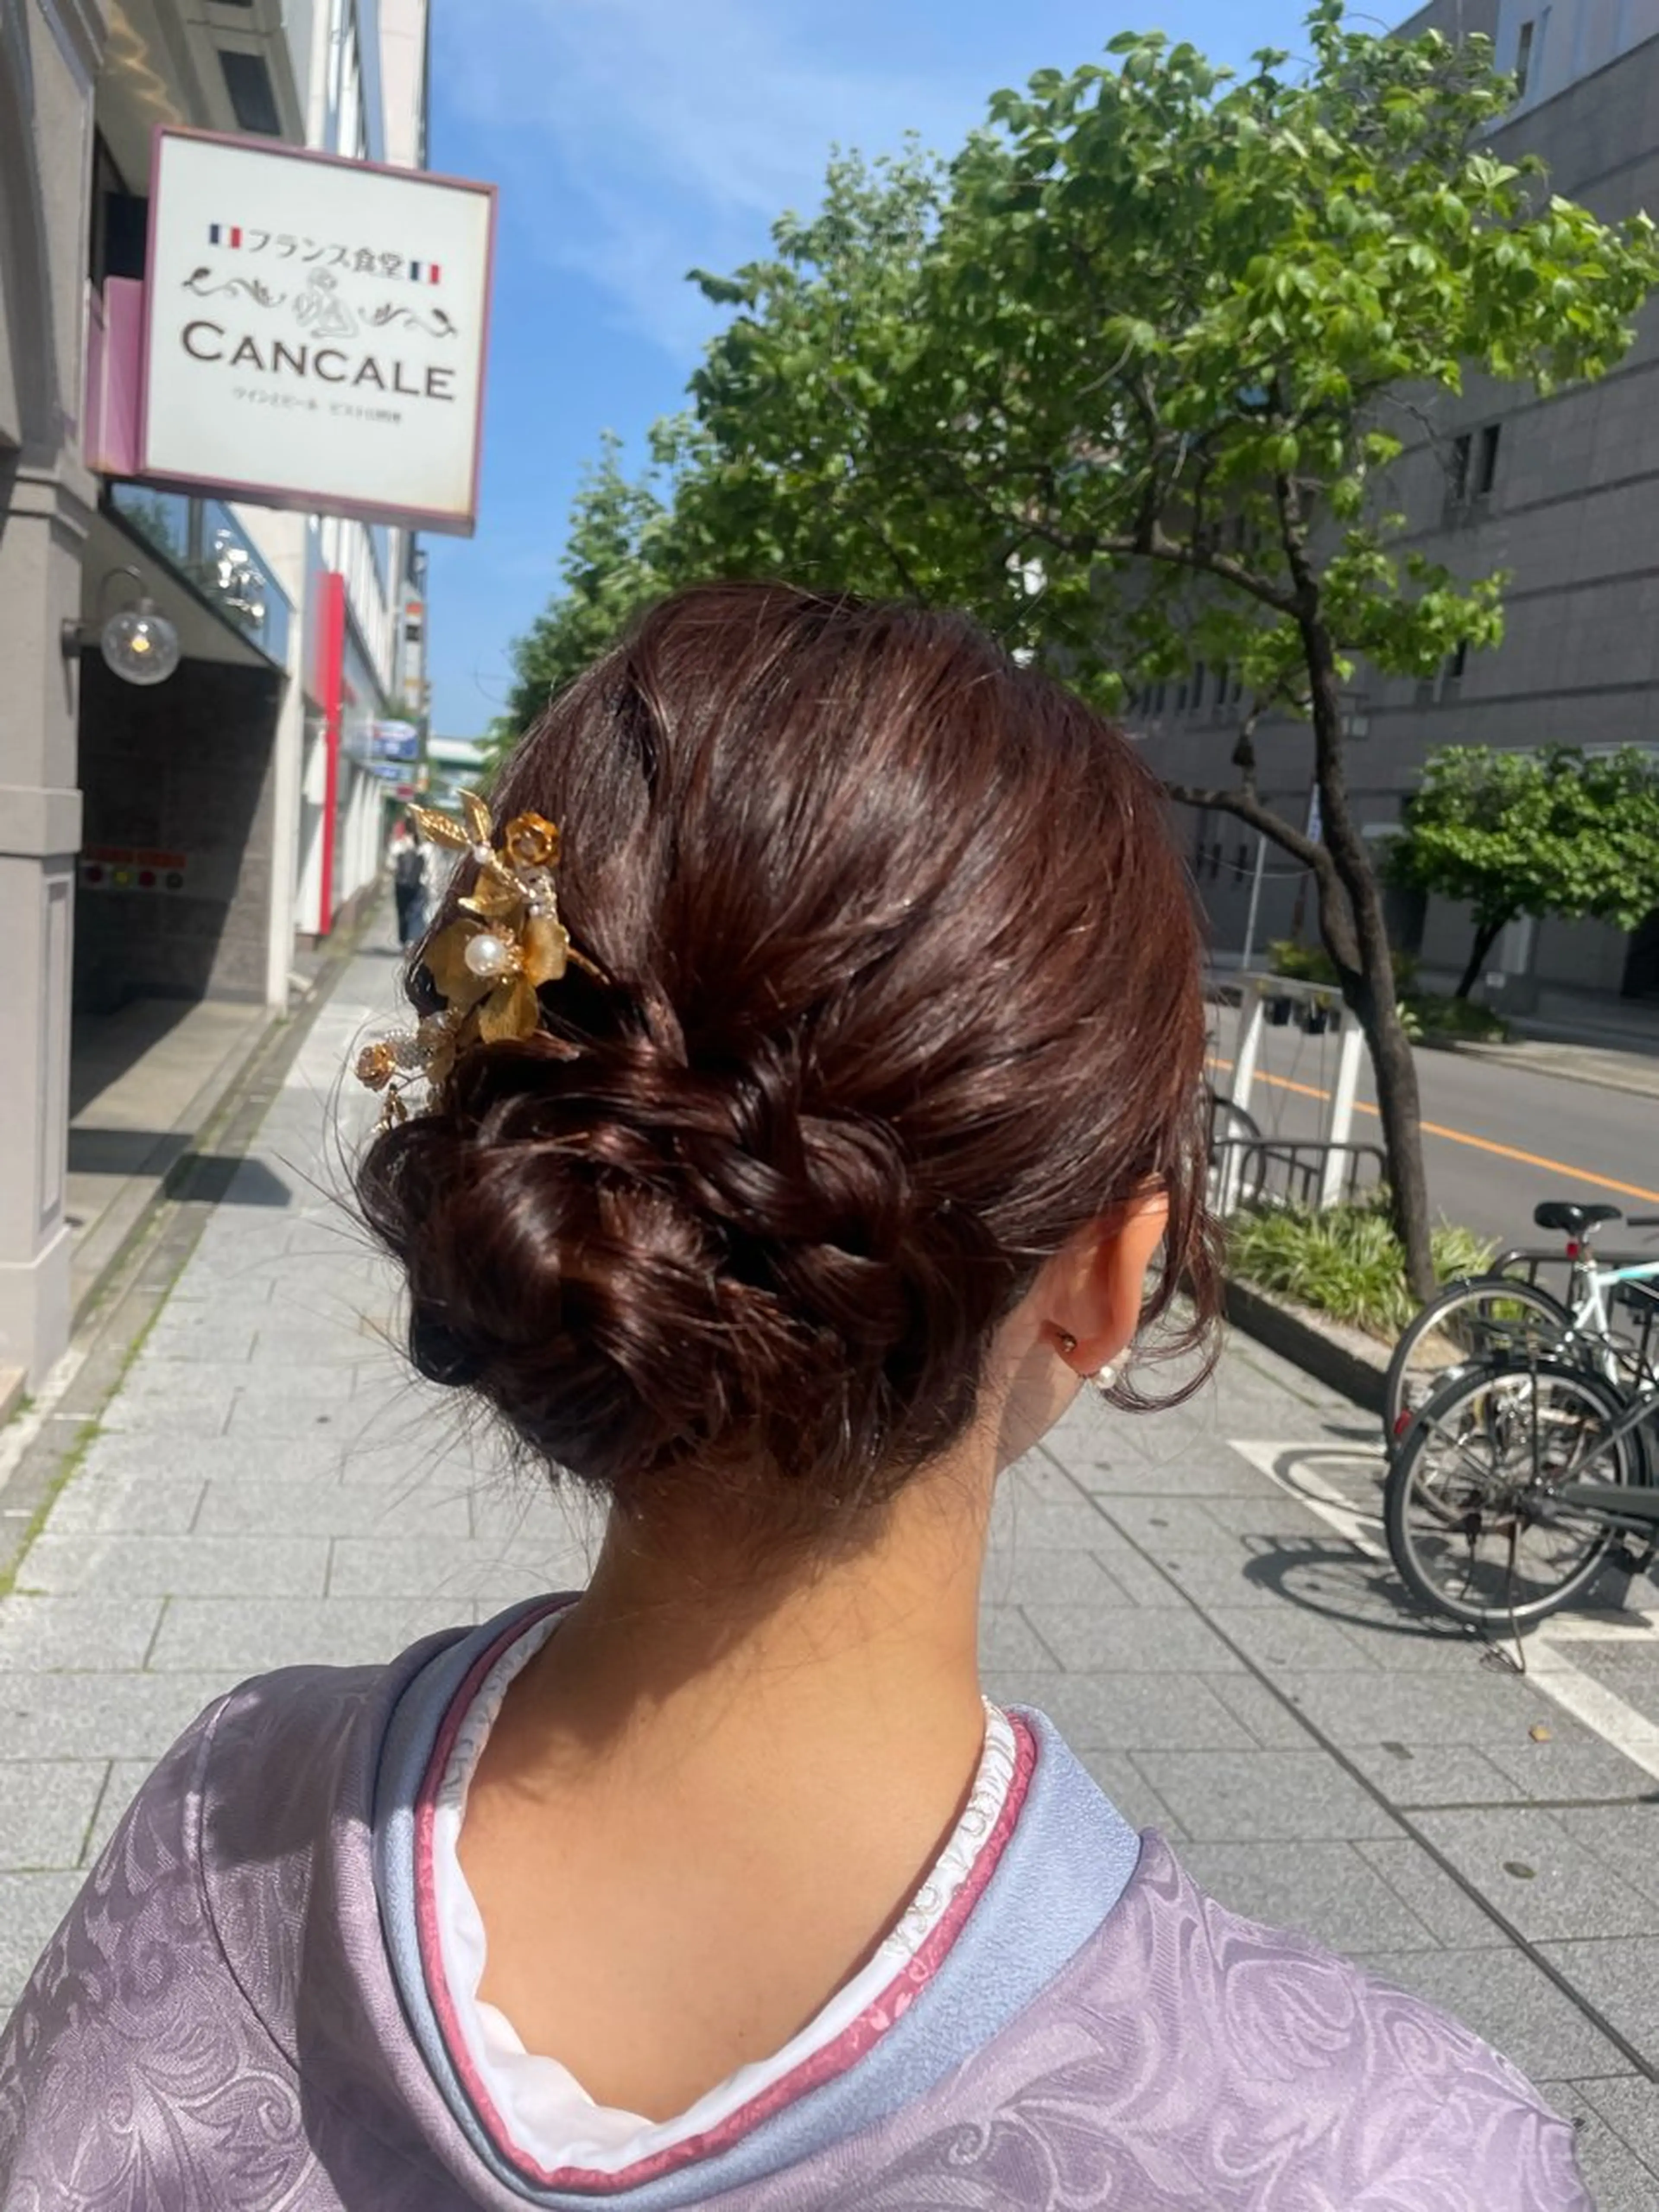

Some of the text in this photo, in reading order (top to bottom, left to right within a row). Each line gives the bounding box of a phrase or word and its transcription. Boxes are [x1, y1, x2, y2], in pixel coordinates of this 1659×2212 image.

[249, 229, 404, 279] フランス食堂
[181, 321, 455, 401] CANCALE
